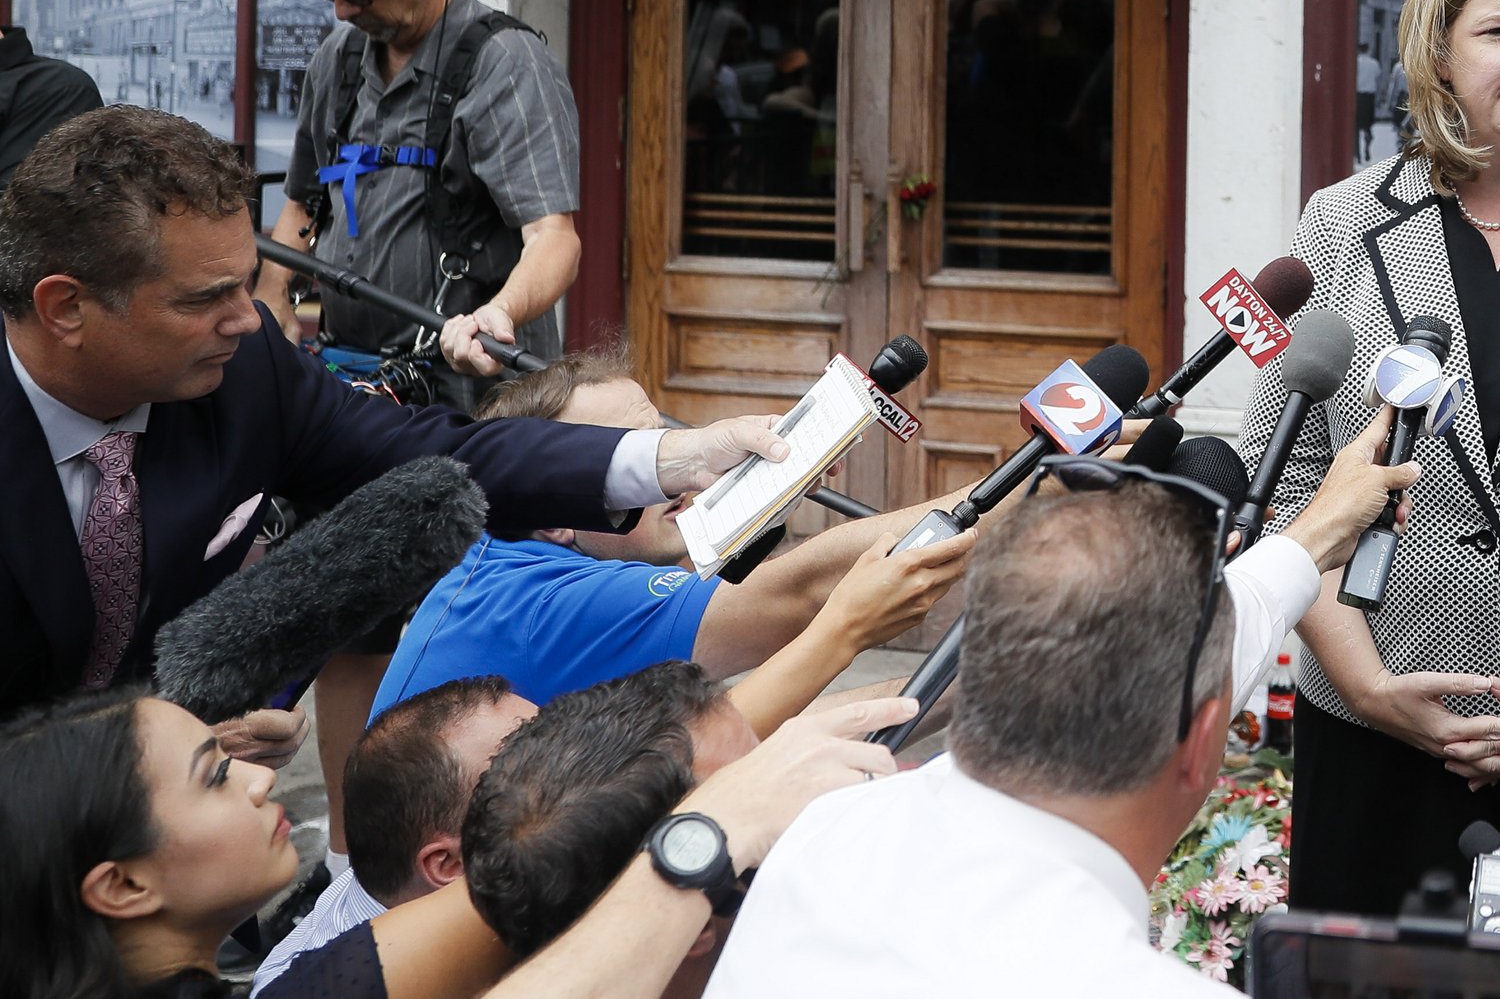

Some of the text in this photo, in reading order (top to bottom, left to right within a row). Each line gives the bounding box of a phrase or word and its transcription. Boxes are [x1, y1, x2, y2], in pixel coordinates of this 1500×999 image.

[1206, 284, 1277, 357] NOW
[1229, 276, 1288, 340] DAYTON 24/7
[1038, 385, 1102, 436] 2
